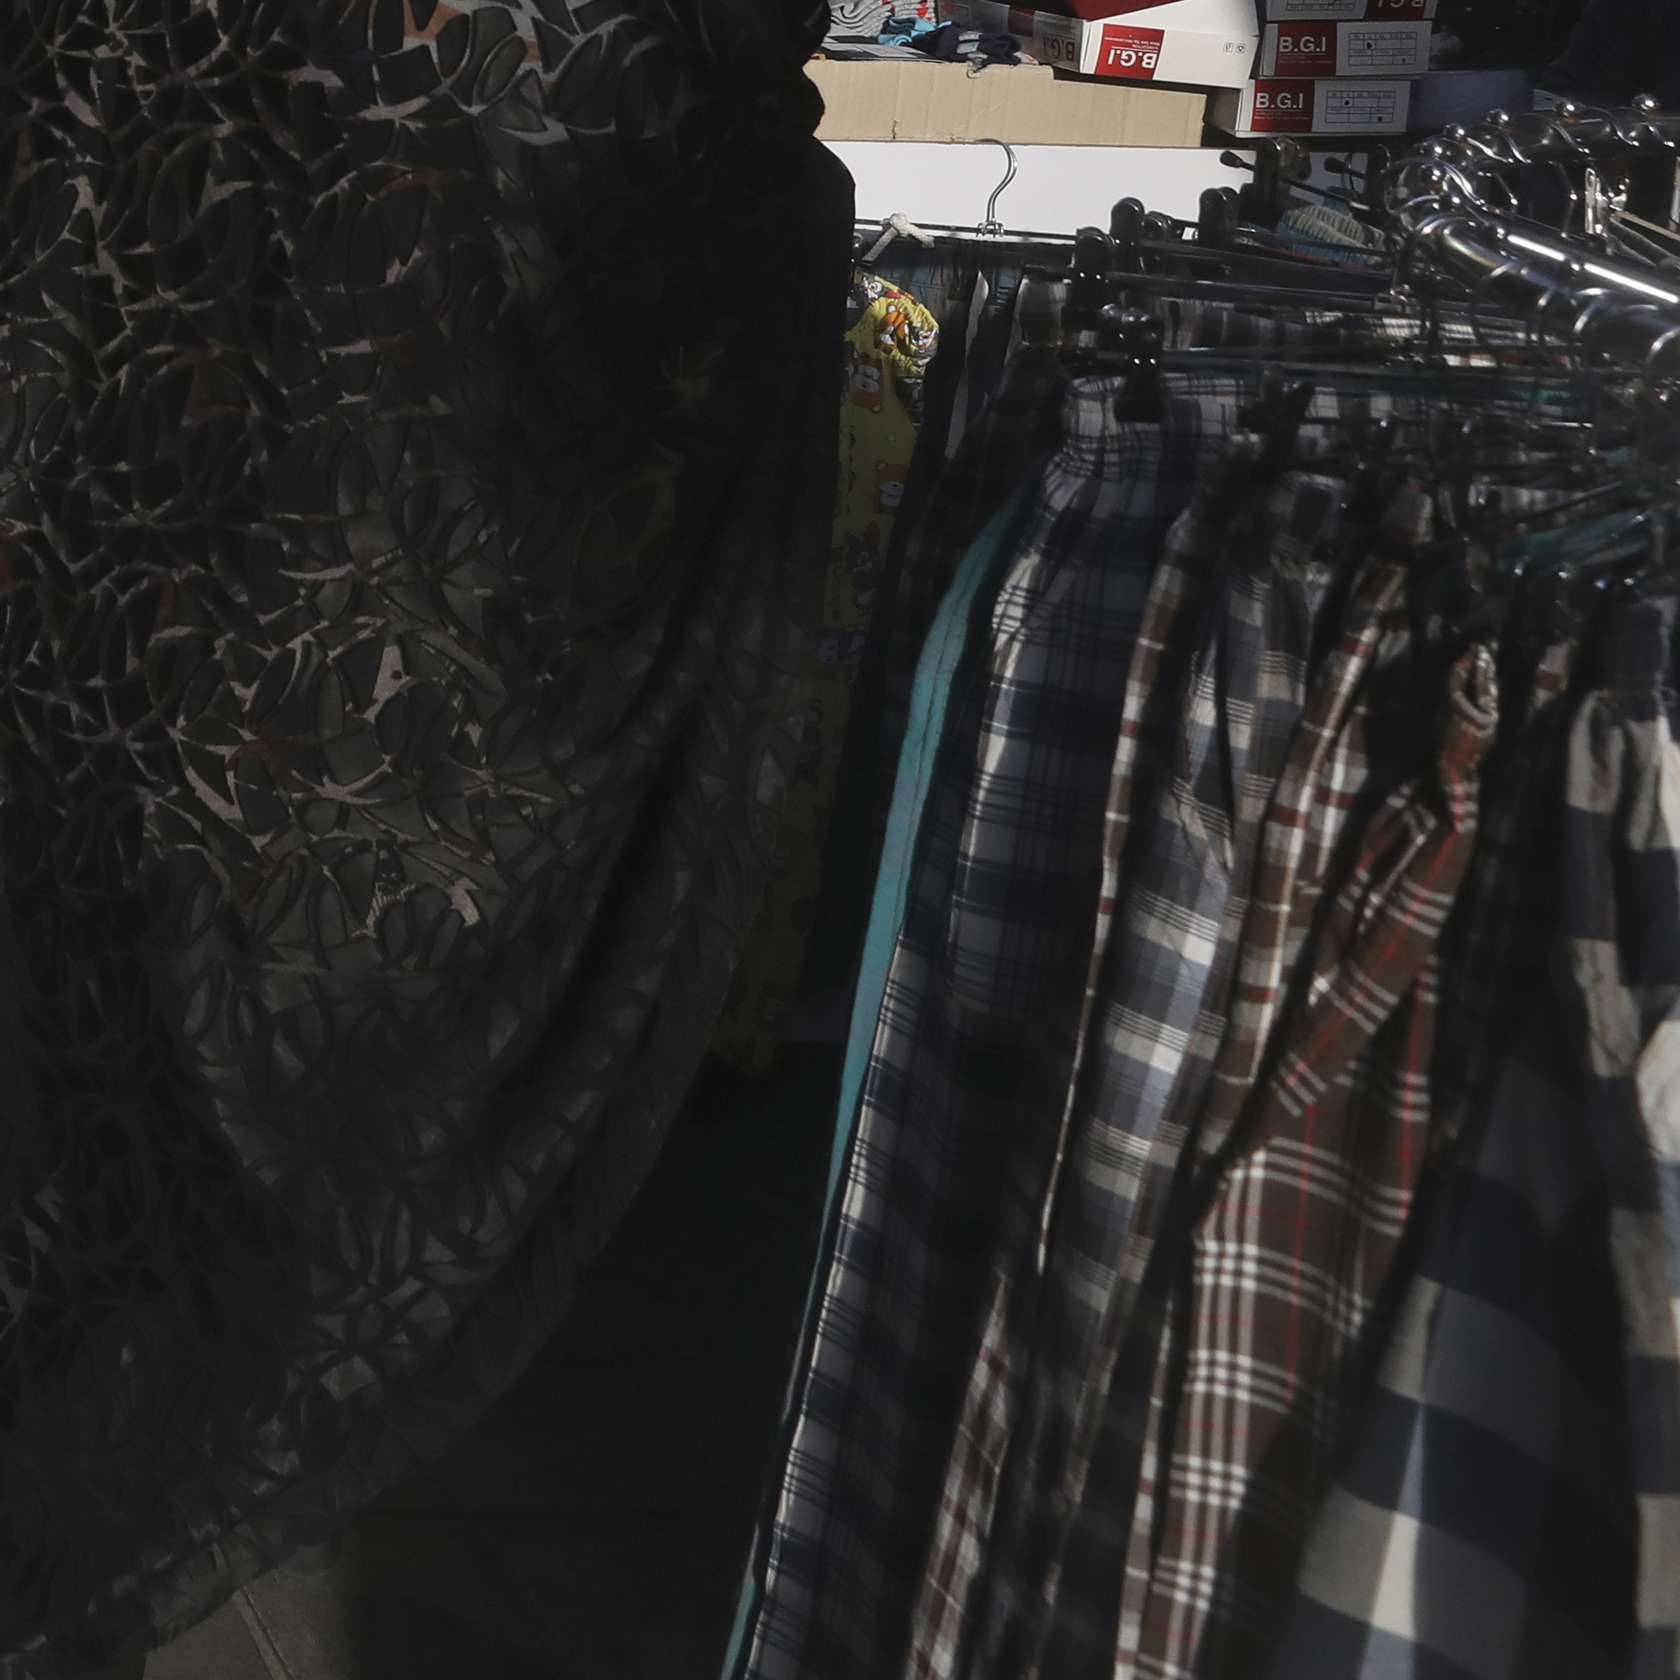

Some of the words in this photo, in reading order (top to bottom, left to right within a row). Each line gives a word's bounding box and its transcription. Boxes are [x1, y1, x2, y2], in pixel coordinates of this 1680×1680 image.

[1278, 35, 1327, 54] B.G.I
[1107, 48, 1159, 69] B.G.I
[1254, 92, 1304, 110] B.G.I
